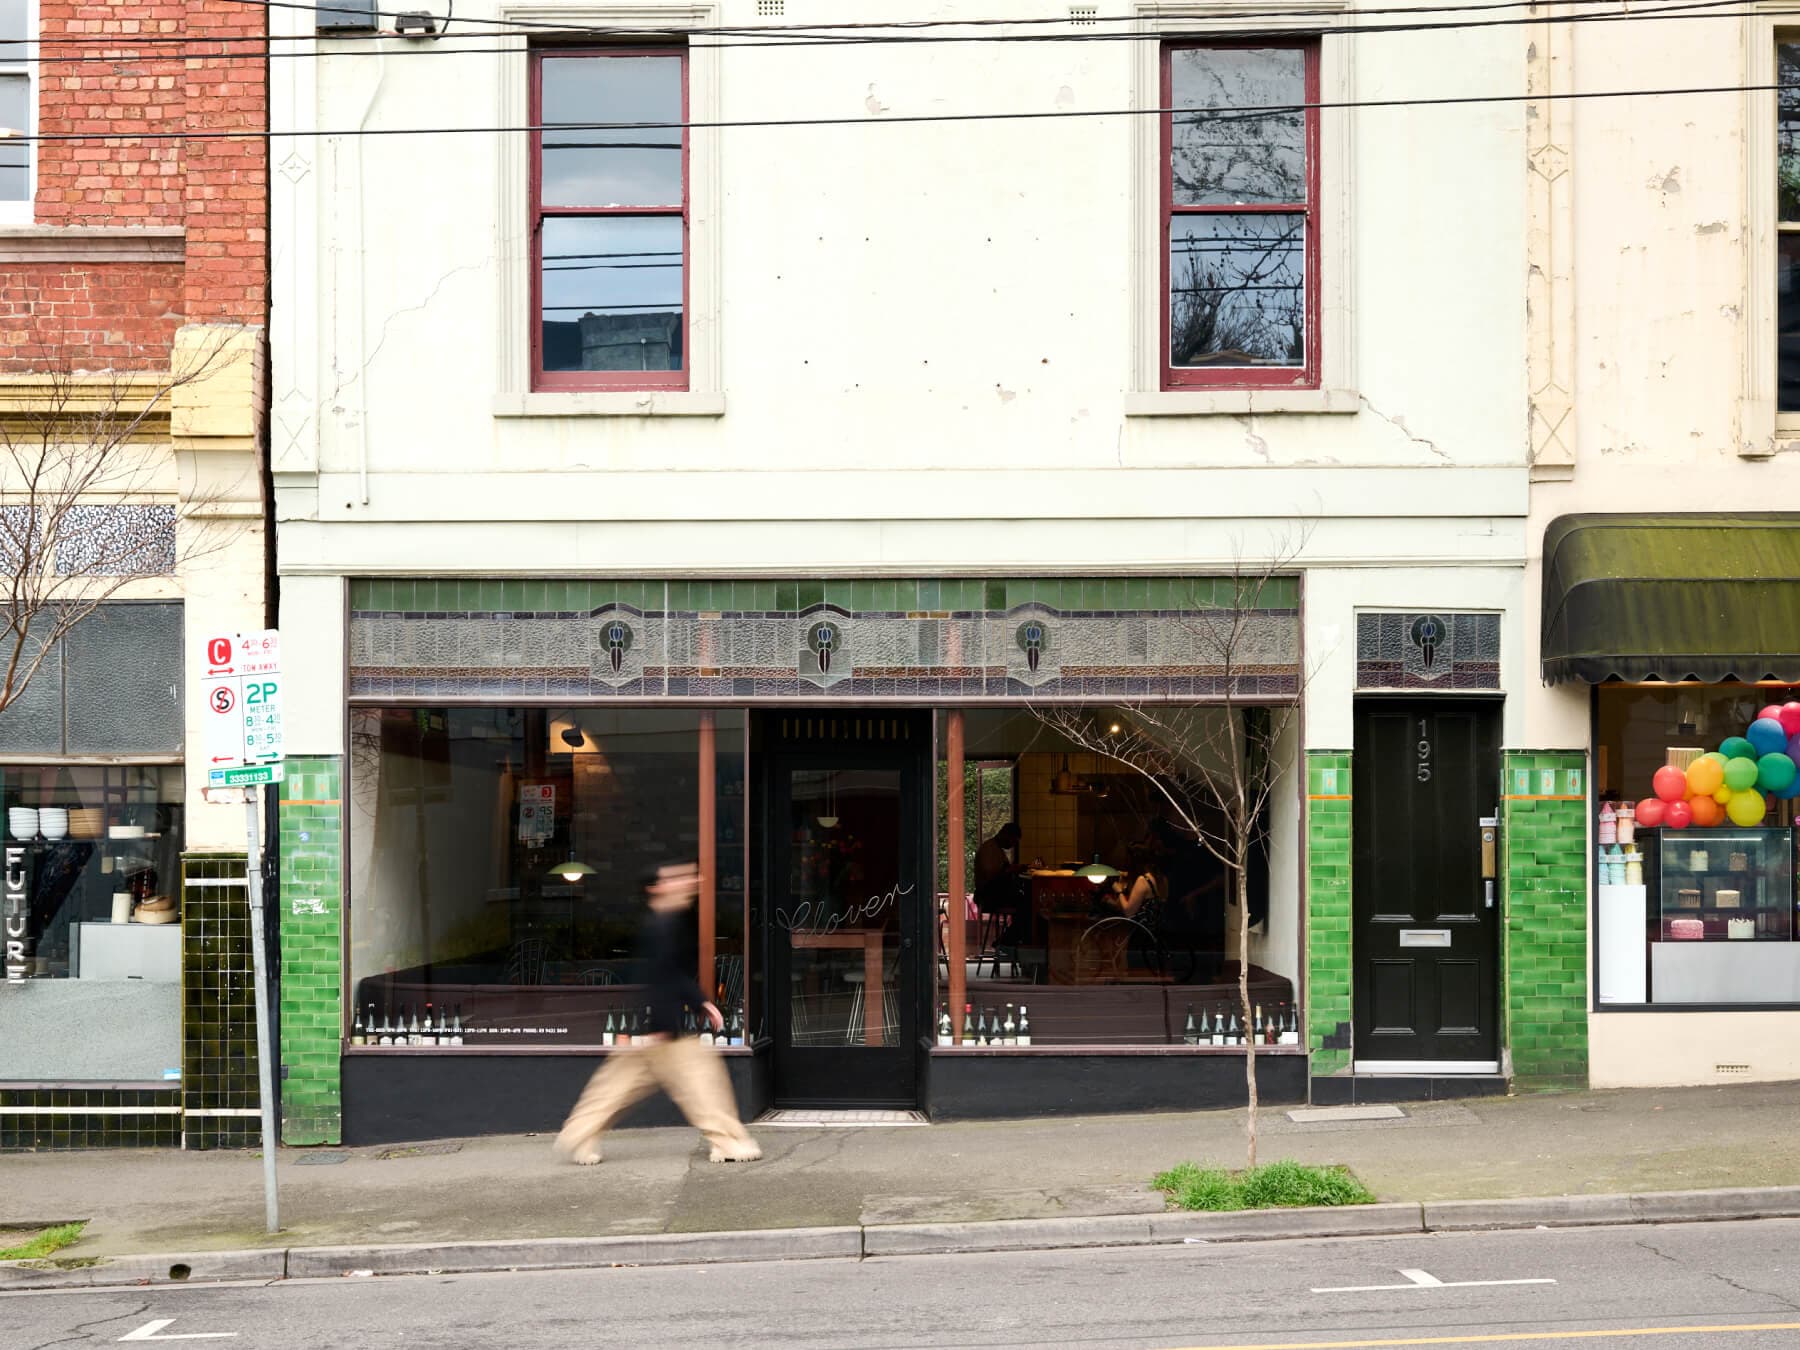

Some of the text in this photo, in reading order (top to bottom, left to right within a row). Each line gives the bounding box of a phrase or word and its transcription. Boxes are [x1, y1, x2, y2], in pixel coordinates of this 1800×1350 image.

[213, 640, 227, 664] C
[246, 682, 278, 704] 2P
[1417, 720, 1432, 782] 195
[5, 847, 27, 985] FUTURE
